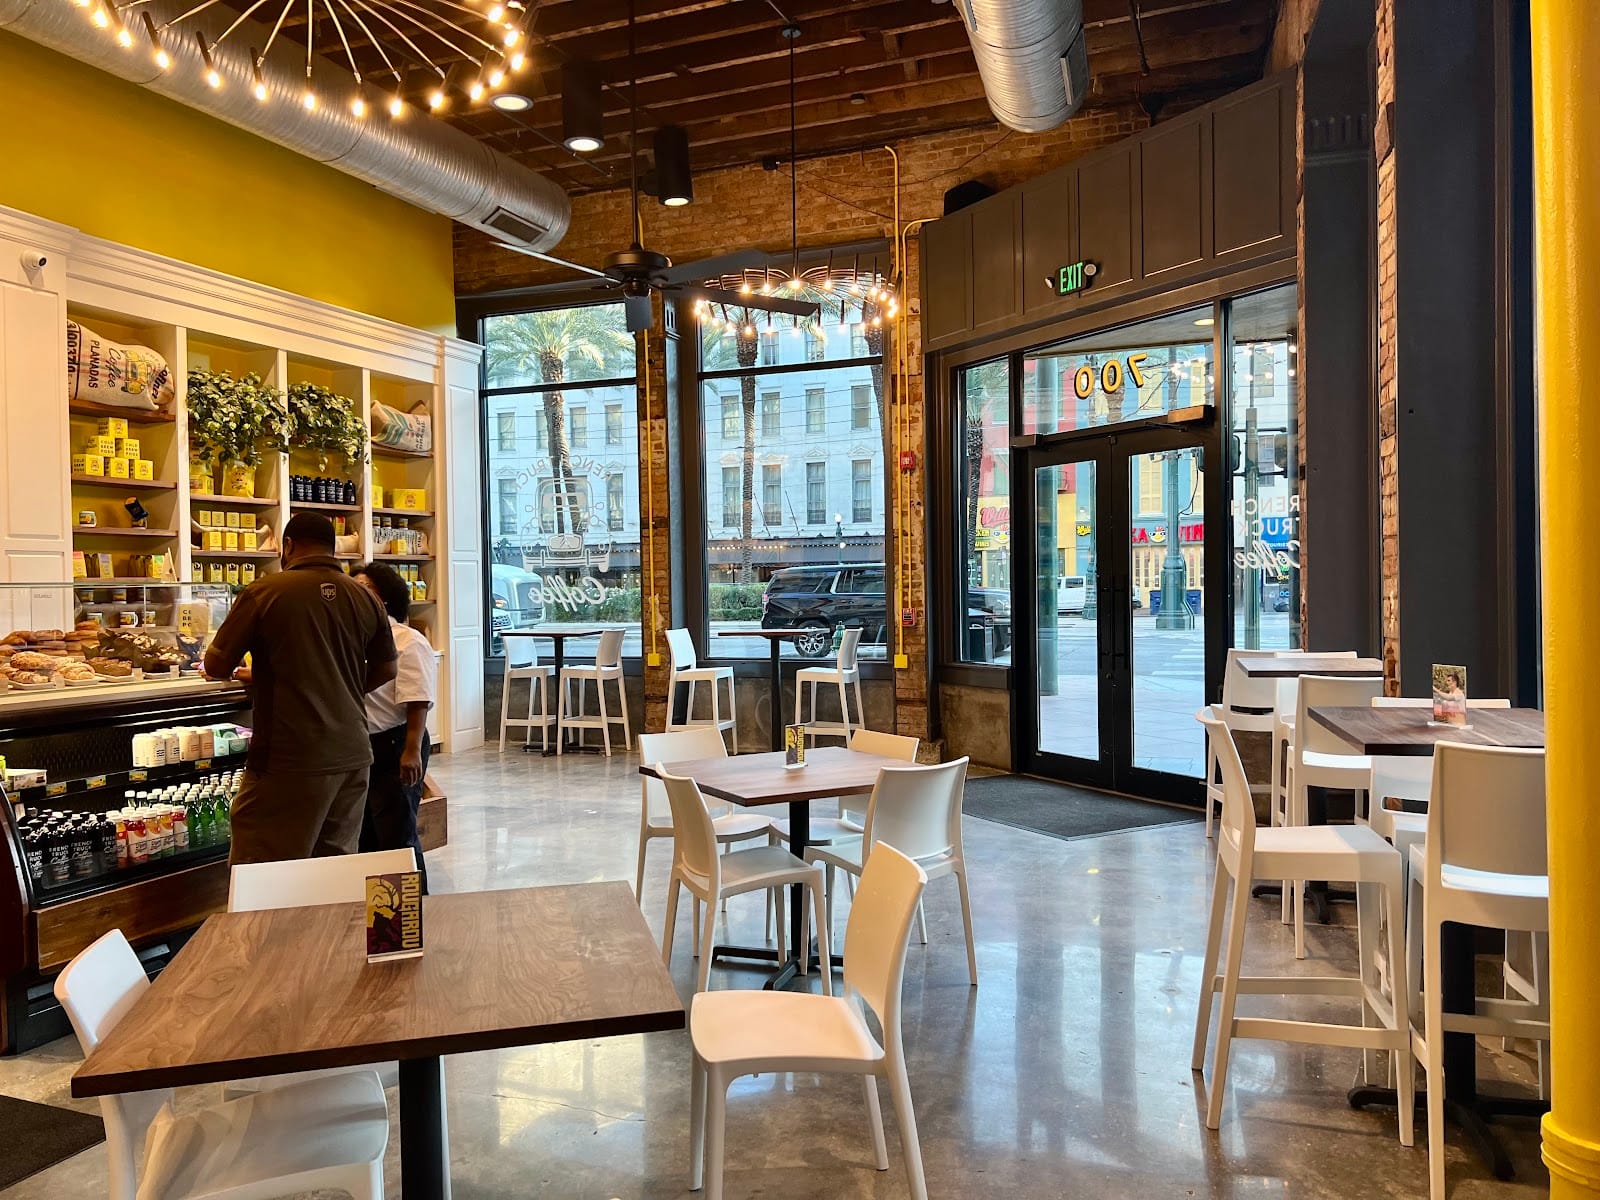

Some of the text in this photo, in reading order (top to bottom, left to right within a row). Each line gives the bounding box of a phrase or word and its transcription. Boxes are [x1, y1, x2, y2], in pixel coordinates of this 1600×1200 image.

[1060, 262, 1083, 293] EXIT
[89, 340, 100, 388] PLANADAS
[105, 348, 121, 388] Coffee
[322, 588, 336, 598] ups
[401, 873, 420, 949] ROUGAROU
